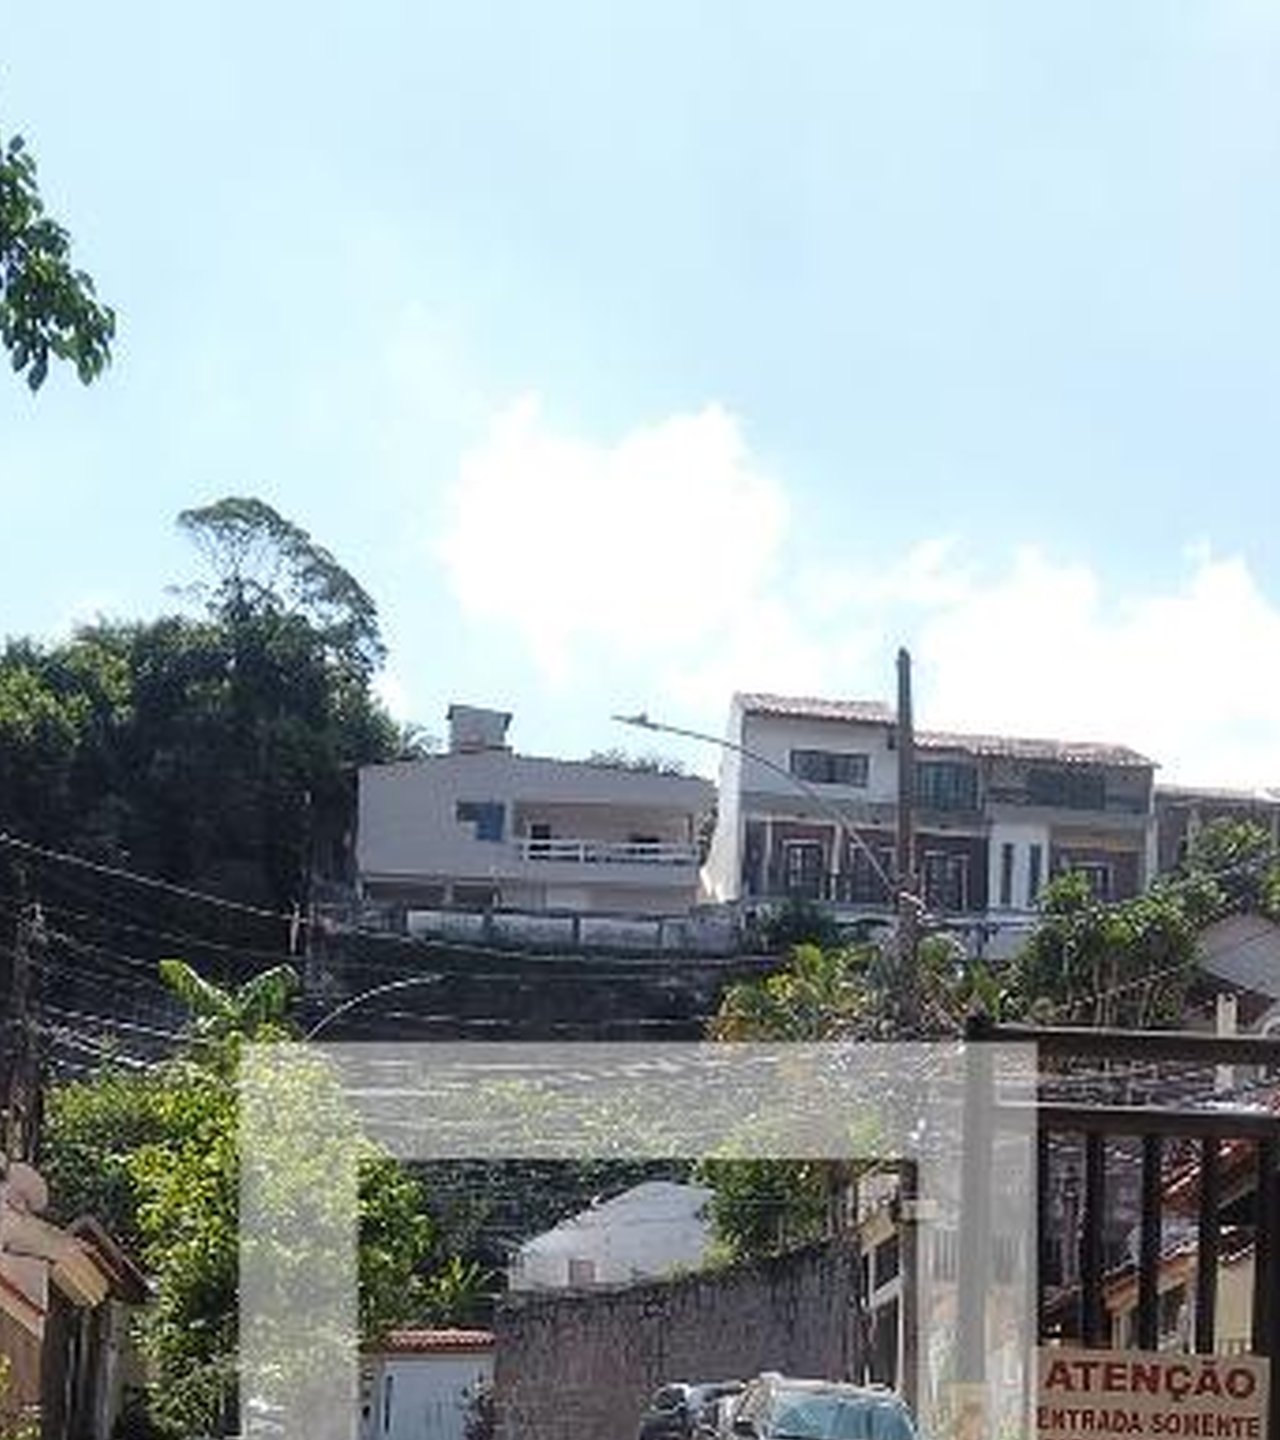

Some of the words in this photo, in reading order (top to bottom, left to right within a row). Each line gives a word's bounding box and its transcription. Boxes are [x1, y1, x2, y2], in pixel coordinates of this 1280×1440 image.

[1044, 1359, 1258, 1402] ATENÇÃO
[1037, 1406, 1143, 1435] ENTRADA
[1150, 1410, 1261, 1439] SOMENTE
